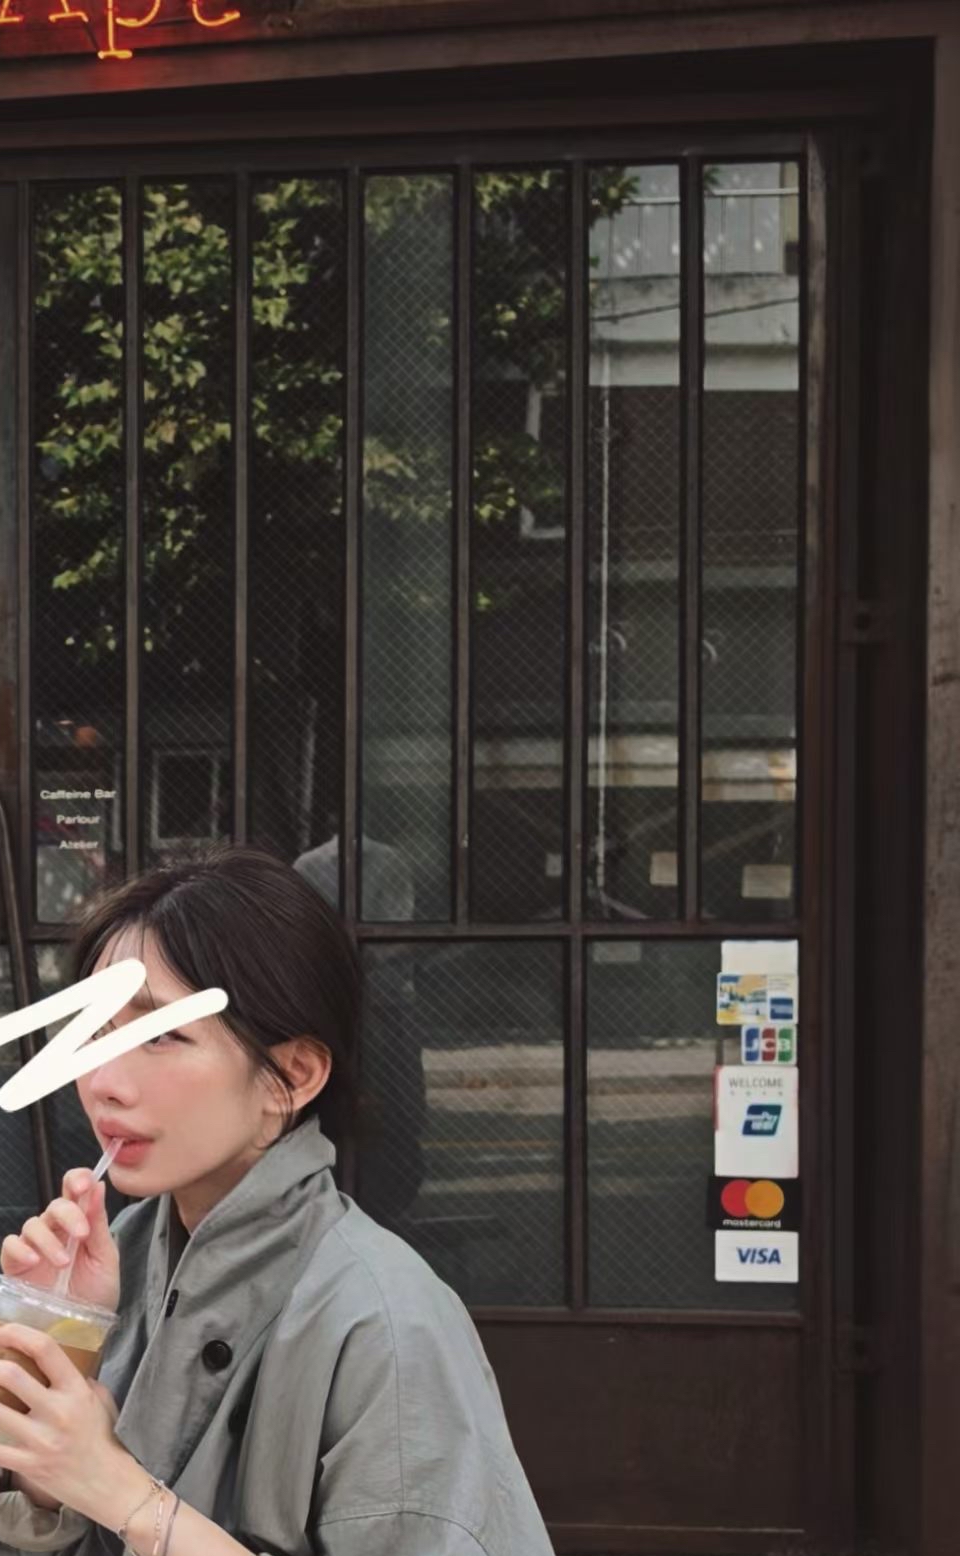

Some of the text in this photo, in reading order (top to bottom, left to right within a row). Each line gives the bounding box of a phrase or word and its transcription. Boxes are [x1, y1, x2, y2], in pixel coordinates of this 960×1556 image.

[40, 788, 116, 799] Caffeine Bar
[56, 814, 100, 824] Parlour
[745, 1036, 791, 1054] JCB
[728, 1077, 784, 1089] WELCOME
[722, 1218, 782, 1229] mastercard
[736, 1247, 781, 1265] VISA
